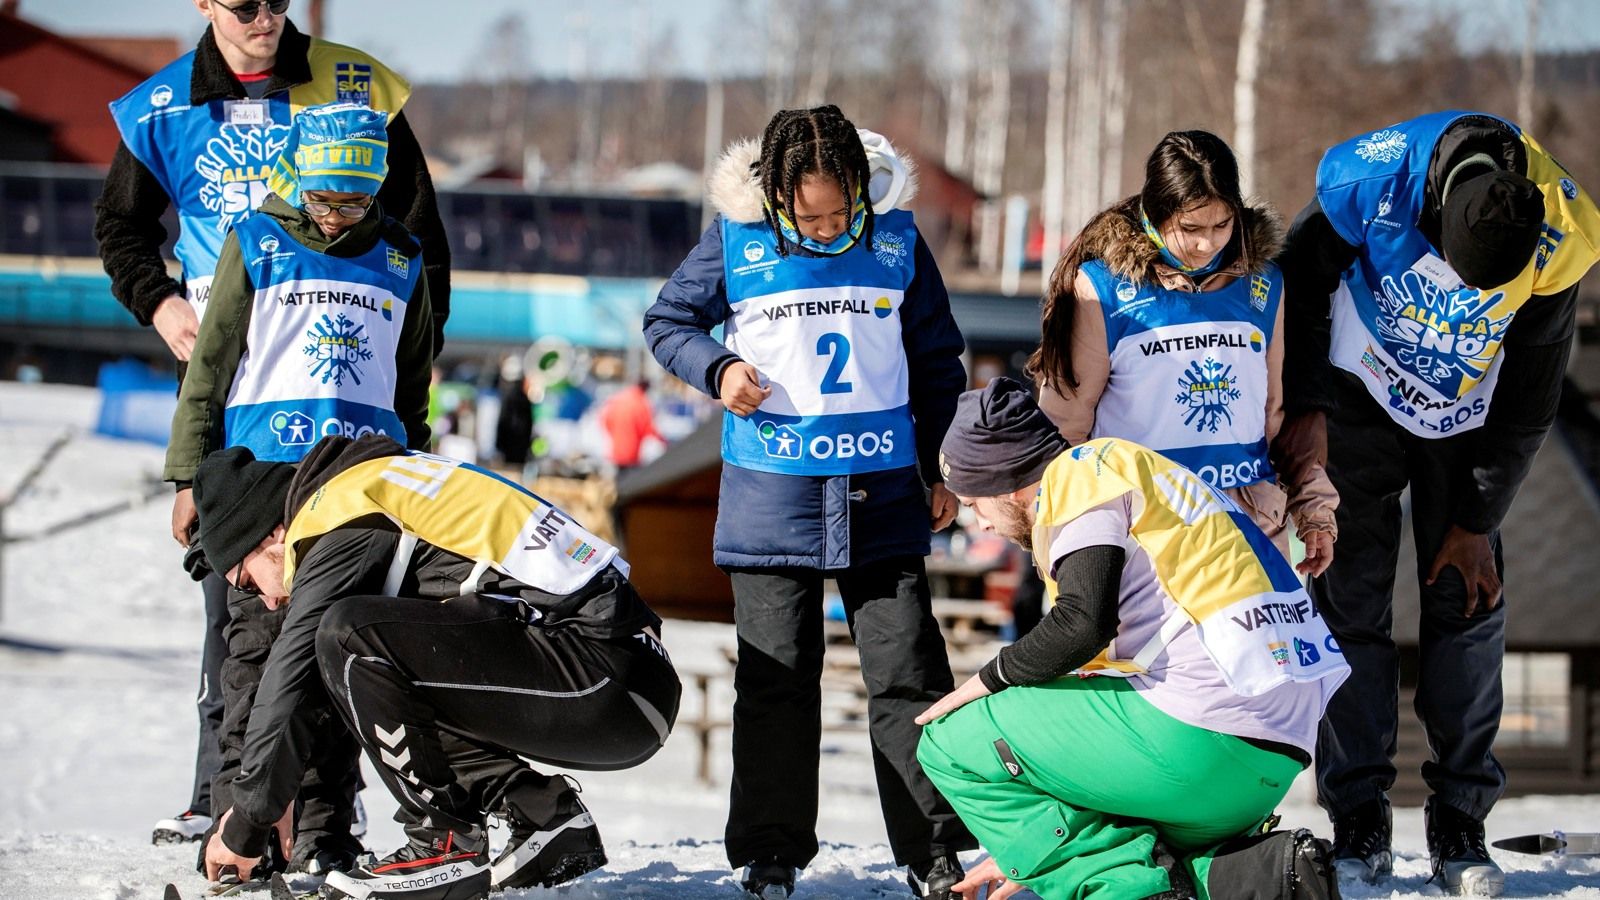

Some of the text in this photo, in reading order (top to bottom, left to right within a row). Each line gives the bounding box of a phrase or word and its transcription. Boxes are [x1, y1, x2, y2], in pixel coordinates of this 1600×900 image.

[338, 80, 369, 92] SKI
[222, 165, 272, 184] ALLA
[278, 290, 378, 312] VATTENFALL
[763, 299, 870, 321] VATTENFALL
[1401, 304, 1487, 334] ALLA PÅ
[319, 336, 358, 348] ALLA PÅ
[1139, 333, 1247, 357] VATTENFALL
[1394, 317, 1484, 356] SNÖ
[317, 343, 359, 363] SNÖ
[816, 332, 853, 395] 2
[1190, 380, 1214, 392] ALLA
[1189, 388, 1230, 407] SNÖ
[321, 417, 387, 440] OBO
[809, 430, 893, 459] OBOS
